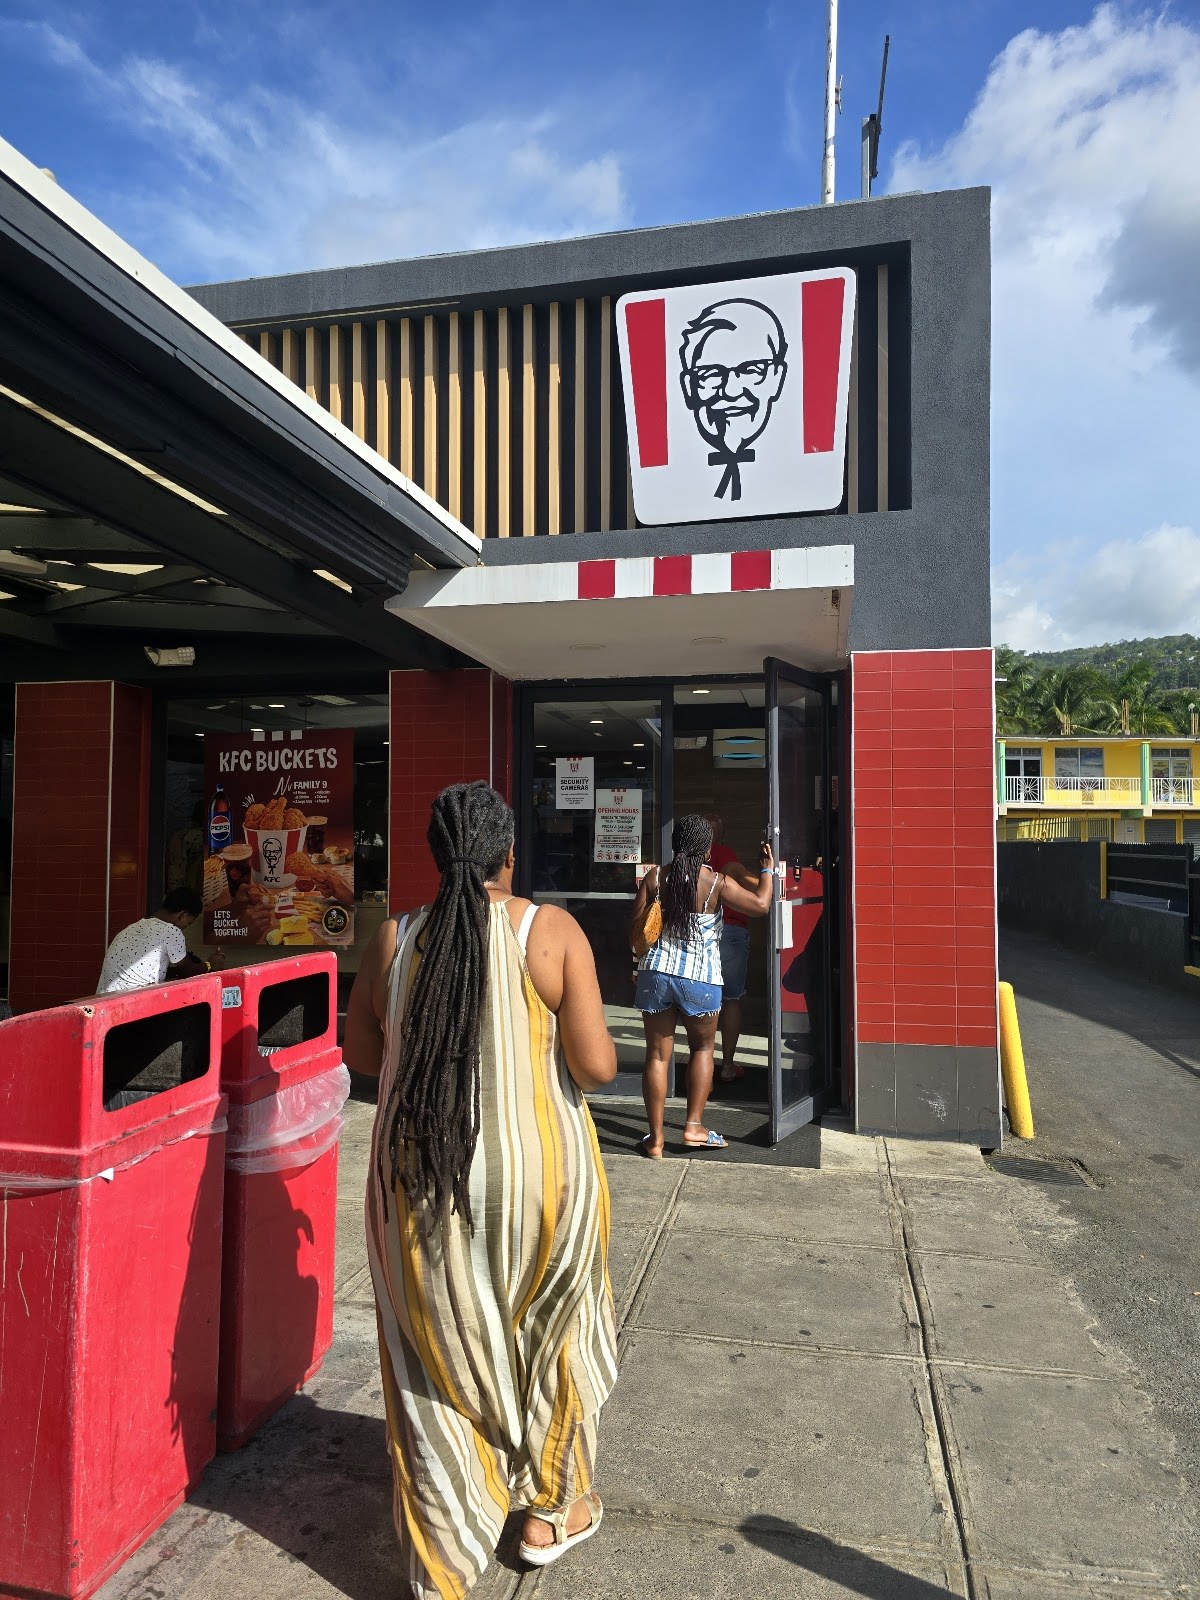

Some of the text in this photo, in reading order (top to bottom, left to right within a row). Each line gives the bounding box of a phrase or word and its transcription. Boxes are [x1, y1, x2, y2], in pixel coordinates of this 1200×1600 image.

[219, 748, 337, 772] KFC BUCKETS
[293, 780, 328, 790] FAMILY 9
[214, 910, 231, 919] LET'S
[213, 919, 239, 927] BUCKET
[213, 927, 248, 936] TOGETHER!
